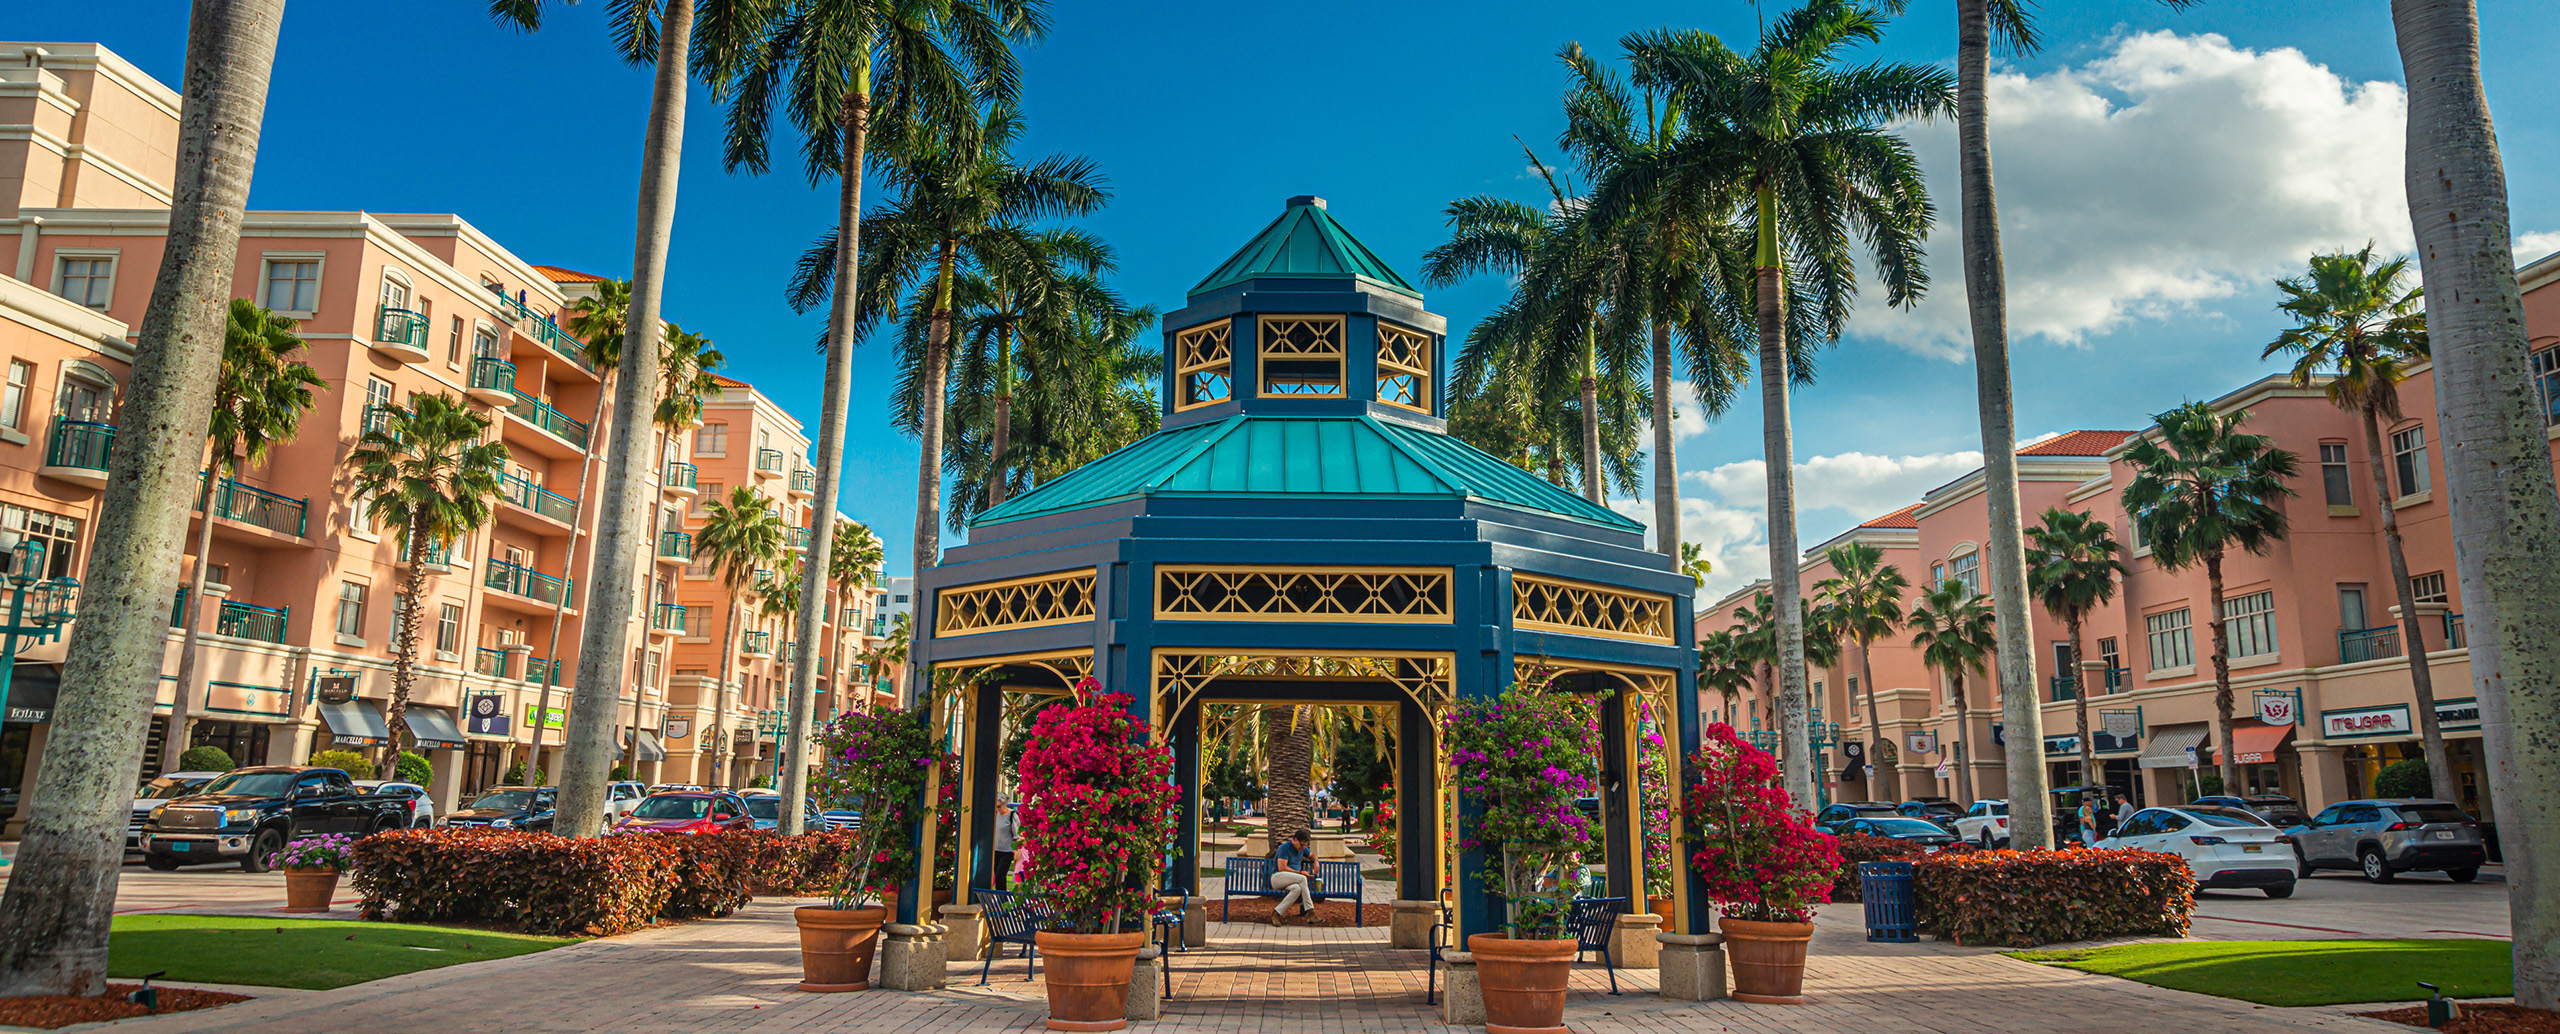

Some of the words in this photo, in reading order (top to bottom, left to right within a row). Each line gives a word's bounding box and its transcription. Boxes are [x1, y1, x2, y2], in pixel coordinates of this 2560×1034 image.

[2331, 714, 2393, 732] IT'SUGAR
[335, 735, 363, 745] MARCELLO
[417, 739, 440, 748] MARCELLO
